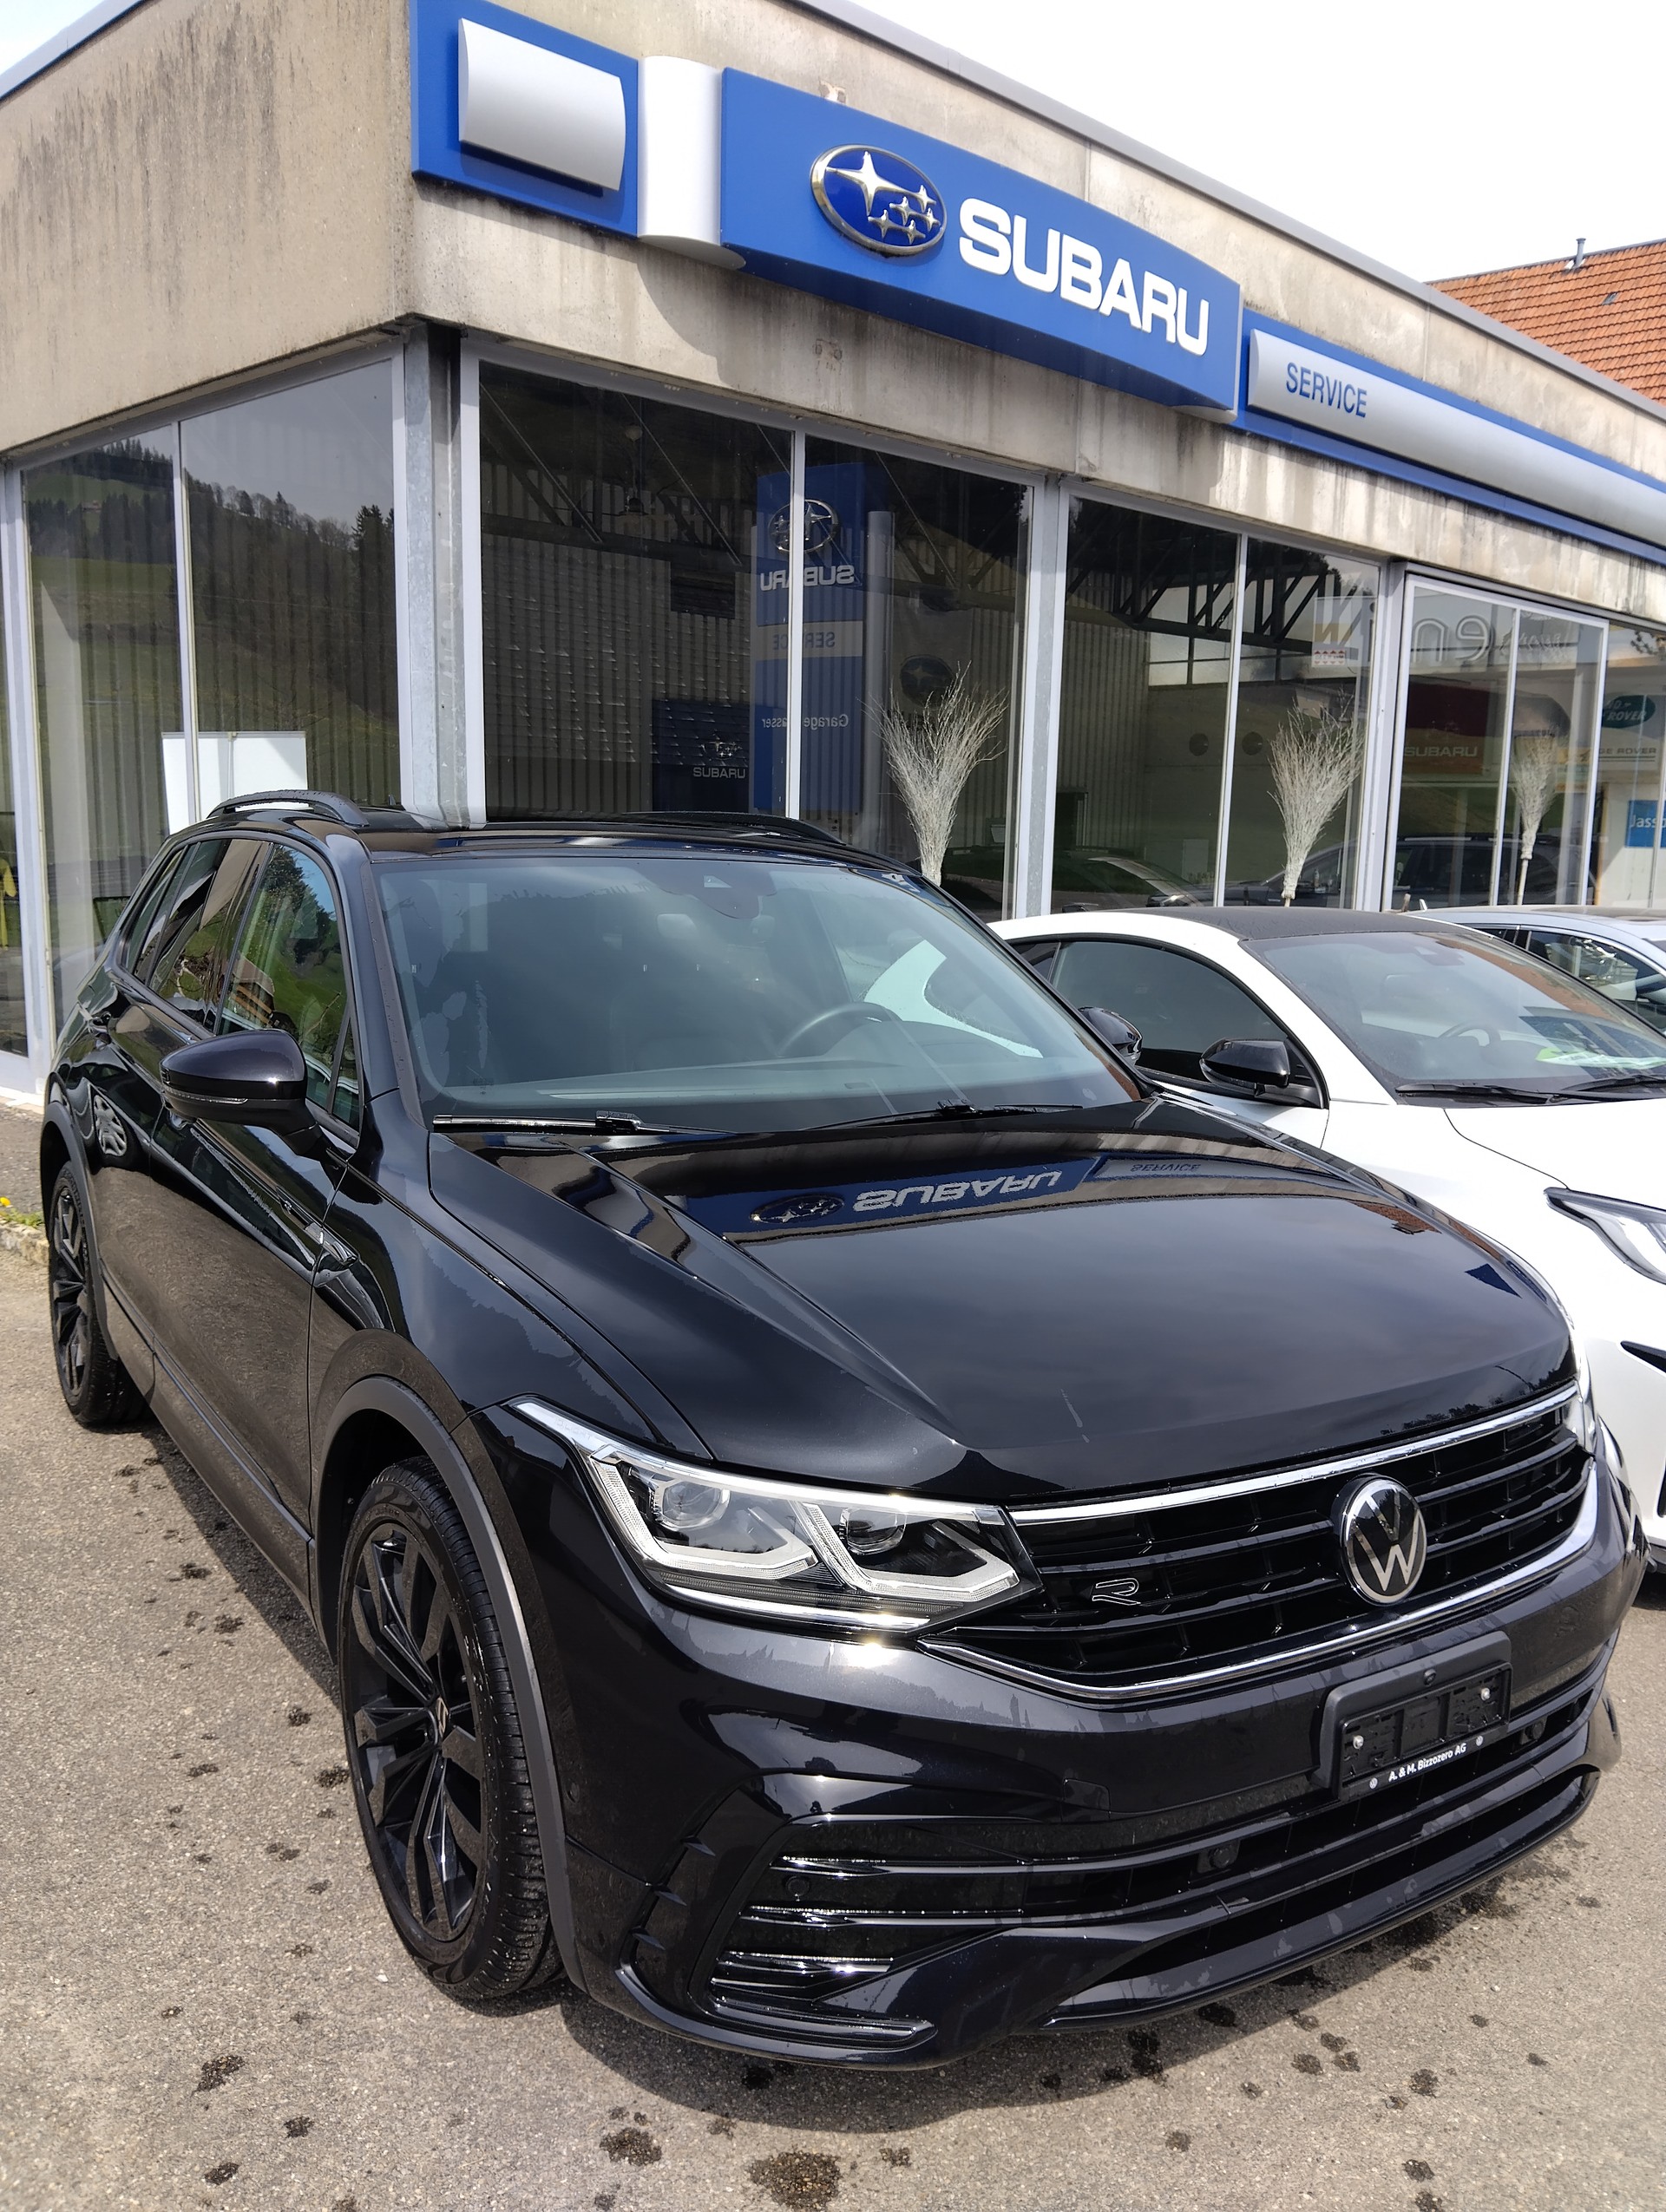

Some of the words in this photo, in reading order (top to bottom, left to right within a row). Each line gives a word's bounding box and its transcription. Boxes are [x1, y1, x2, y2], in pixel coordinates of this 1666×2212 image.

[959, 198, 1210, 357] SUBARU
[1286, 362, 1368, 418] SERVICE
[1405, 747, 1478, 757] SUBARU
[693, 767, 747, 779] SUBARU
[1398, 1766, 1406, 1778] &
[1407, 1763, 1417, 1775] M.
[1417, 1750, 1453, 1771] Bizzozero
[1454, 1742, 1467, 1756] AG
